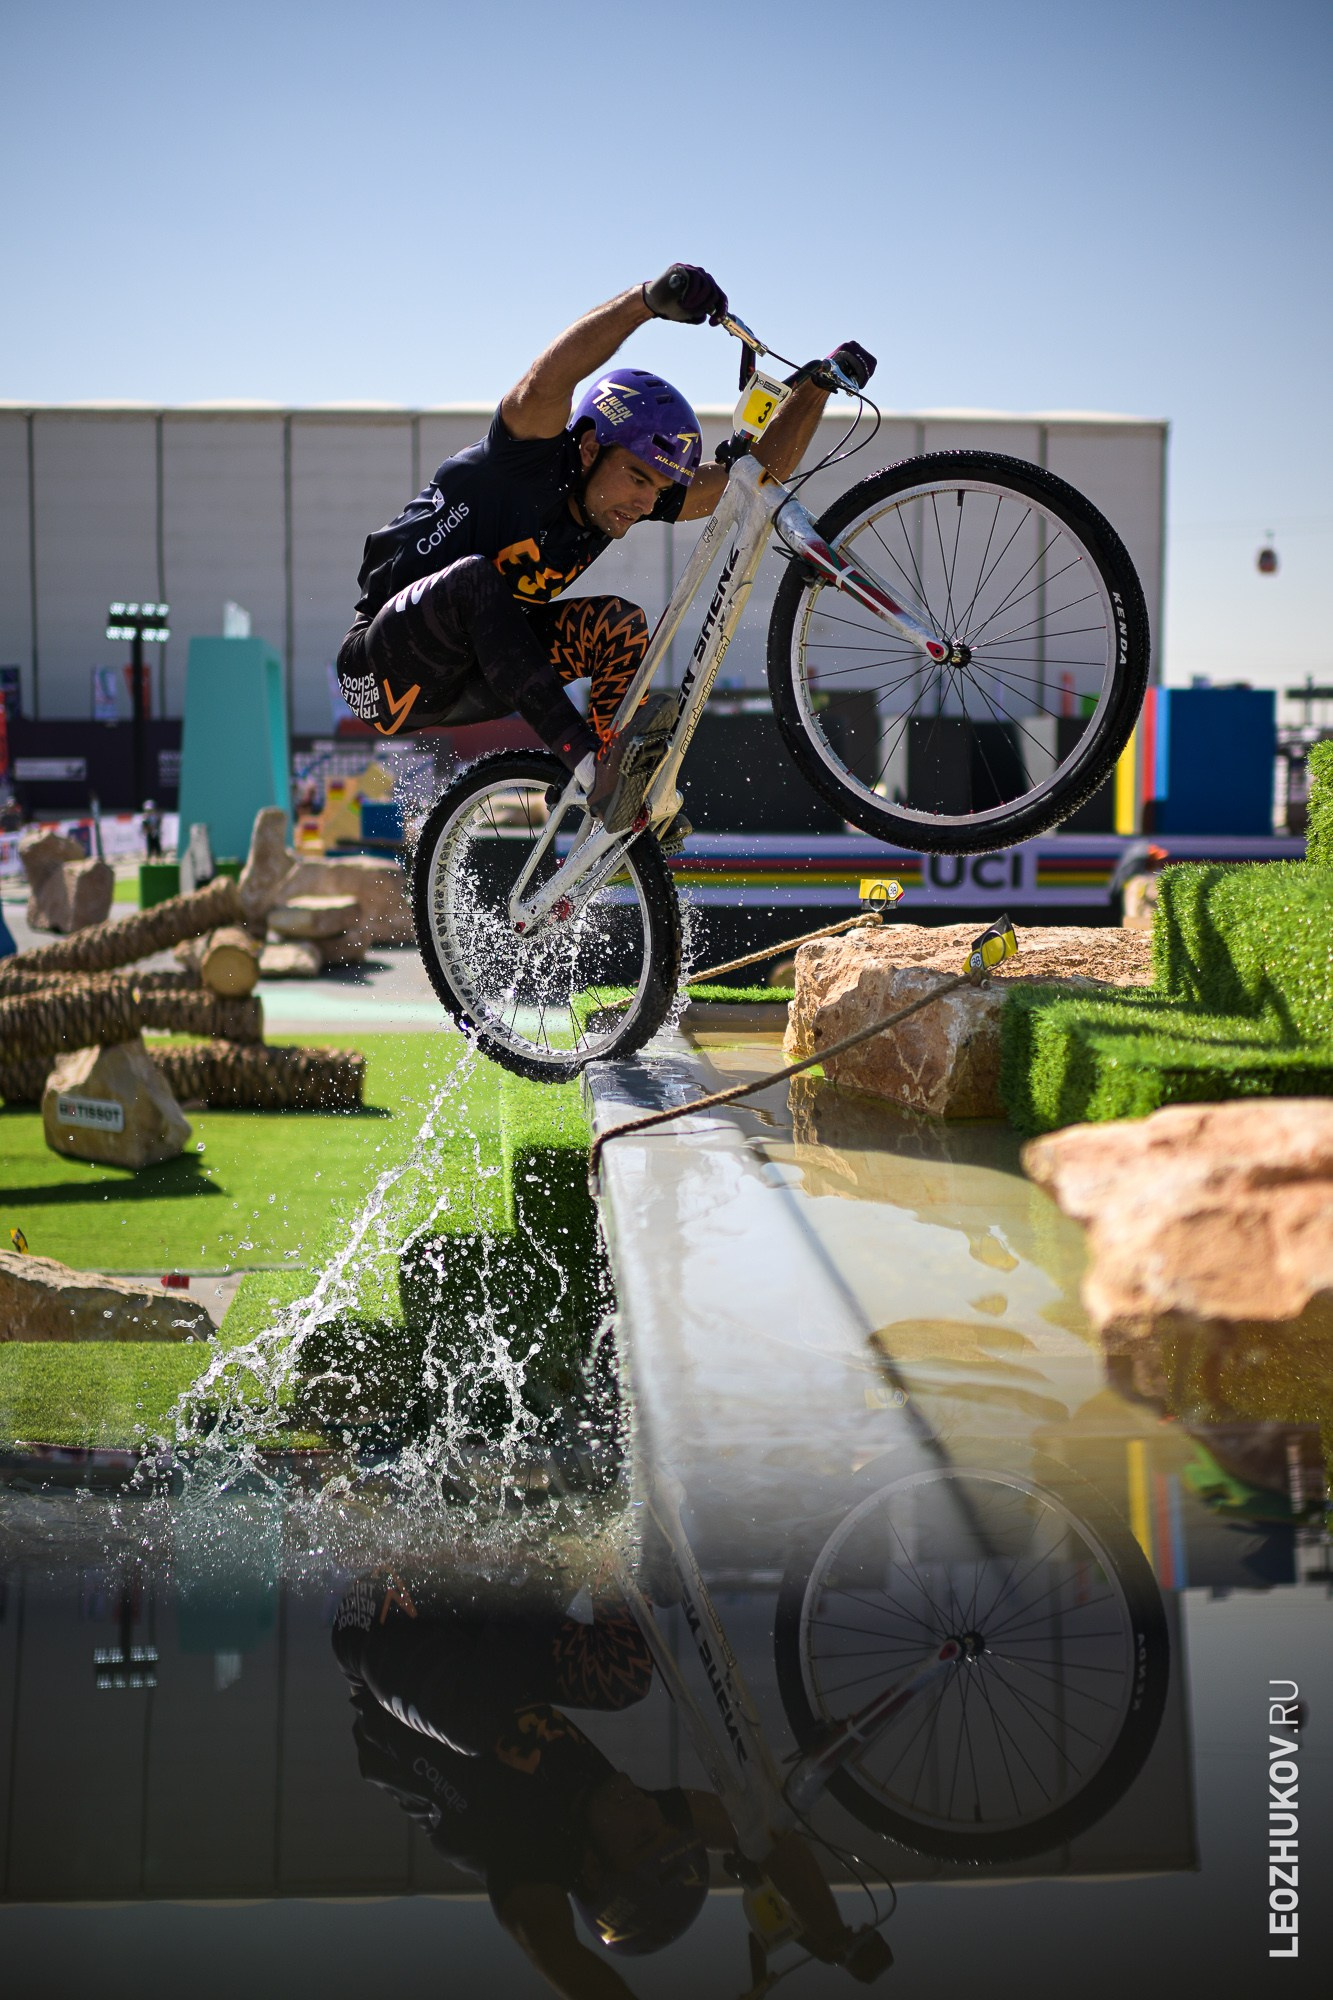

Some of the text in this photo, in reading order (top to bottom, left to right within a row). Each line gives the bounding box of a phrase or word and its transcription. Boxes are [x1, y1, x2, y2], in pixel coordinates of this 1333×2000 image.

[596, 401, 625, 426] SAENZ
[606, 395, 633, 419] JULEN
[758, 401, 773, 424] 3
[655, 454, 679, 471] JULEN
[416, 502, 470, 555] Cofidis
[1112, 591, 1128, 664] KENDA
[342, 672, 376, 693] SCHOOL
[929, 853, 1022, 889] UCI
[77, 1102, 120, 1123] TISSOT
